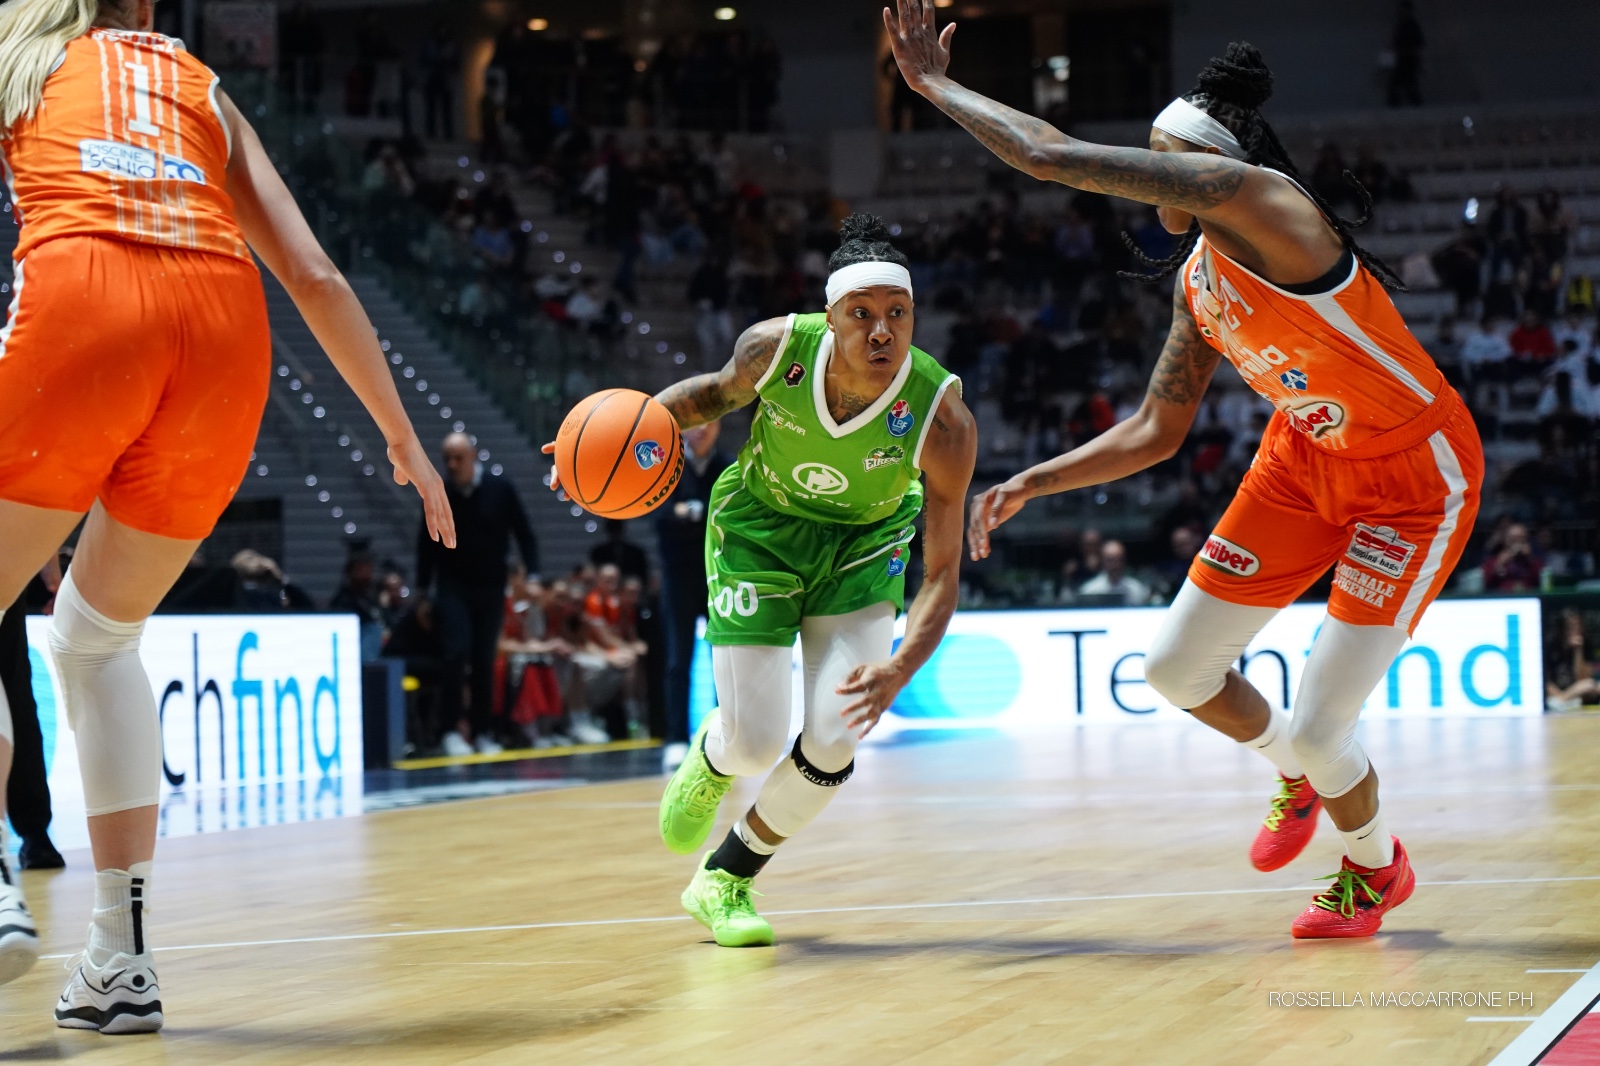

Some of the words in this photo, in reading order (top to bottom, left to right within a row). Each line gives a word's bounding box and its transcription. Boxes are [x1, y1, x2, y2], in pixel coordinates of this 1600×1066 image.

[125, 61, 160, 137] 1
[89, 153, 156, 178] SCHIO
[788, 365, 801, 379] F
[714, 582, 758, 617] 00
[160, 630, 341, 787] chfind
